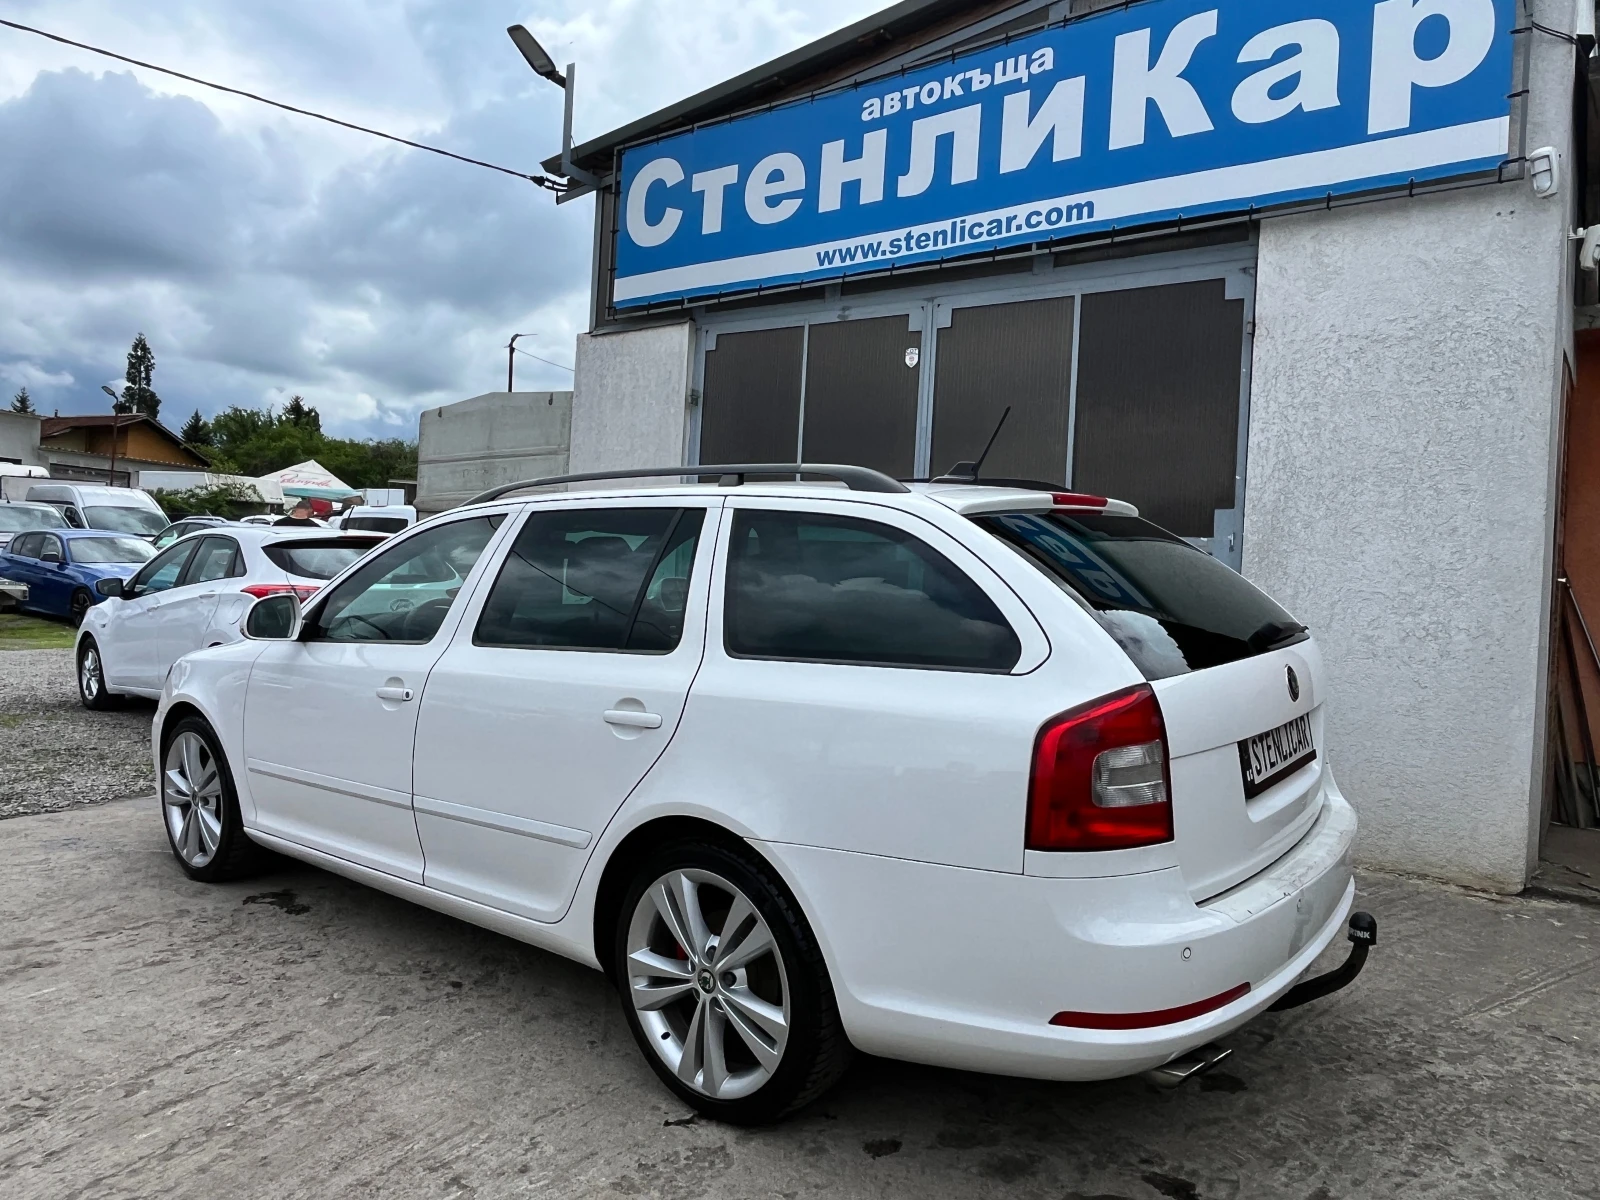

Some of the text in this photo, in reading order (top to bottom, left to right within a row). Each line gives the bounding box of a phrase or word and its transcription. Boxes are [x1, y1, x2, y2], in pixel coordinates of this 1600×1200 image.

[861, 47, 1054, 122] автокъща
[816, 200, 1095, 269] www.stenlicar.com
[1252, 715, 1309, 776] STENLICAR
